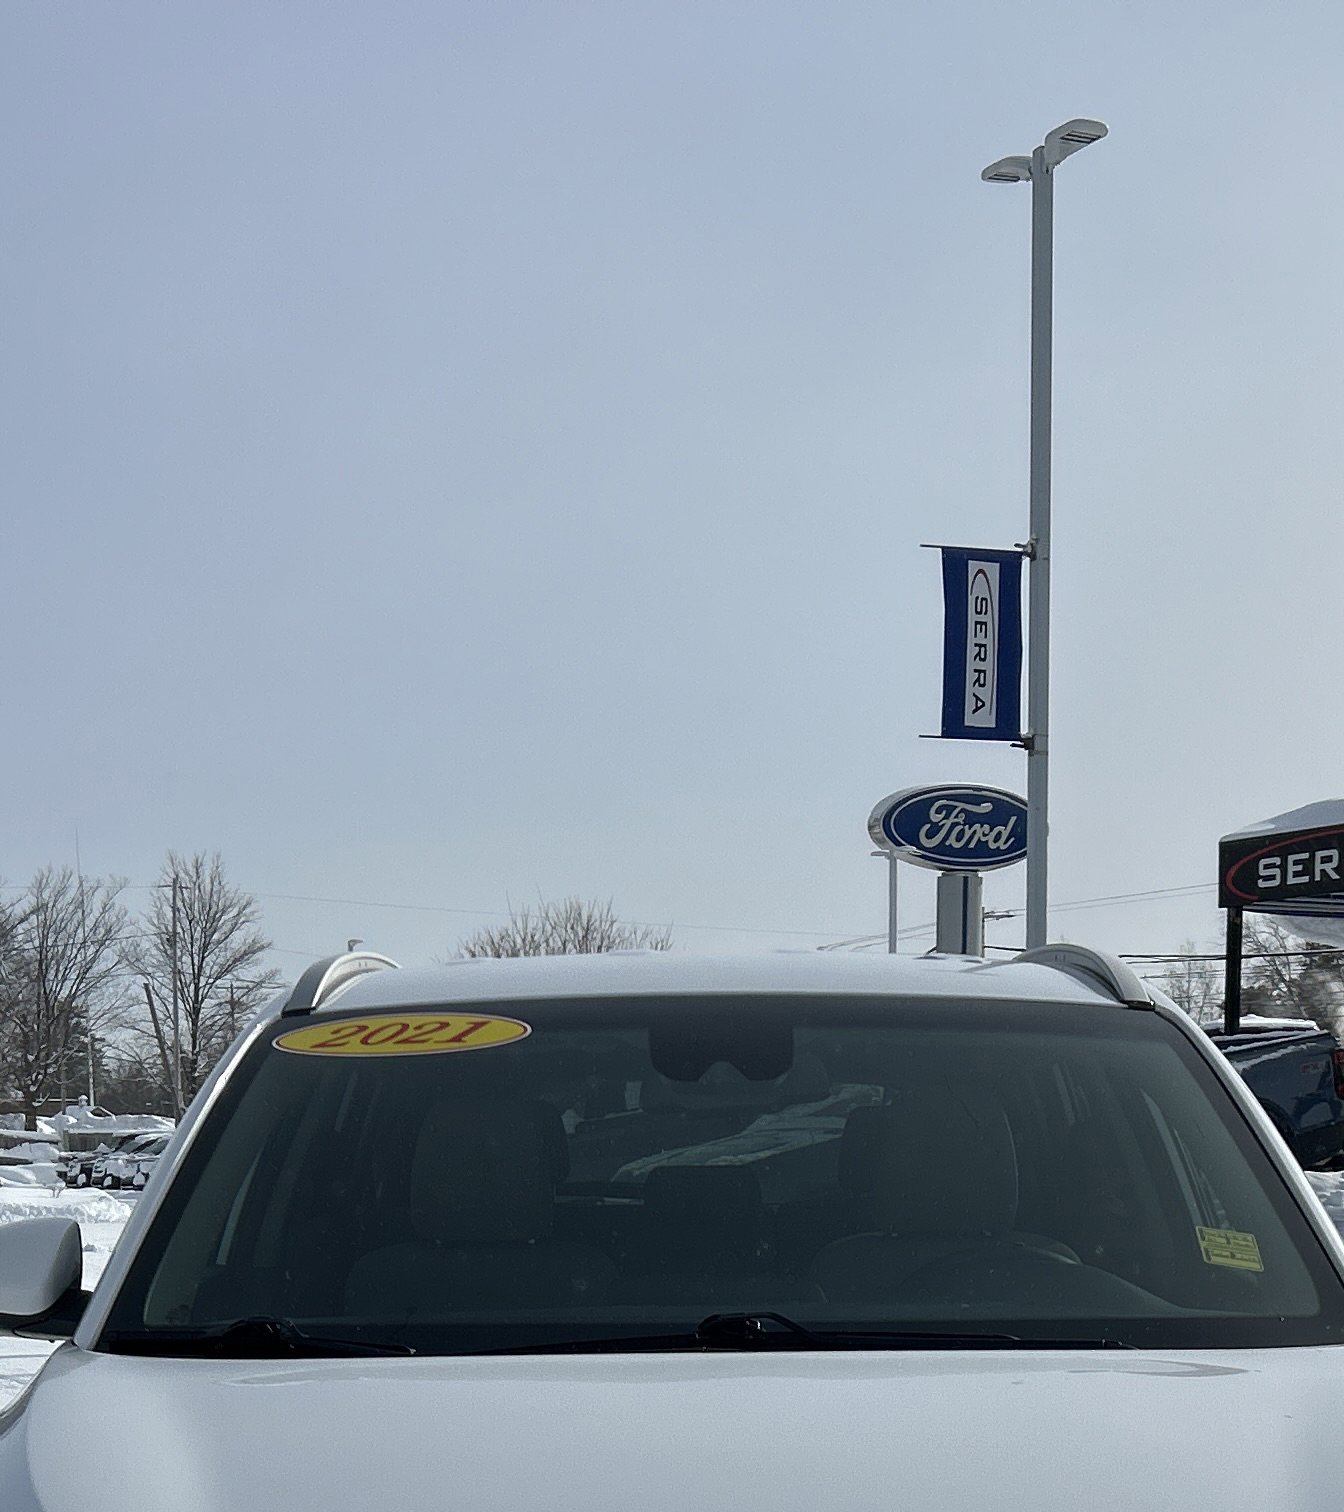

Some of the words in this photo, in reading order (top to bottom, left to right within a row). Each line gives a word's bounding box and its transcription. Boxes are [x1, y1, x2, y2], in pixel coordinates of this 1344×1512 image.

[971, 594, 989, 716] SERRA
[918, 799, 1018, 850] Ford
[308, 1020, 493, 1050] 2021
